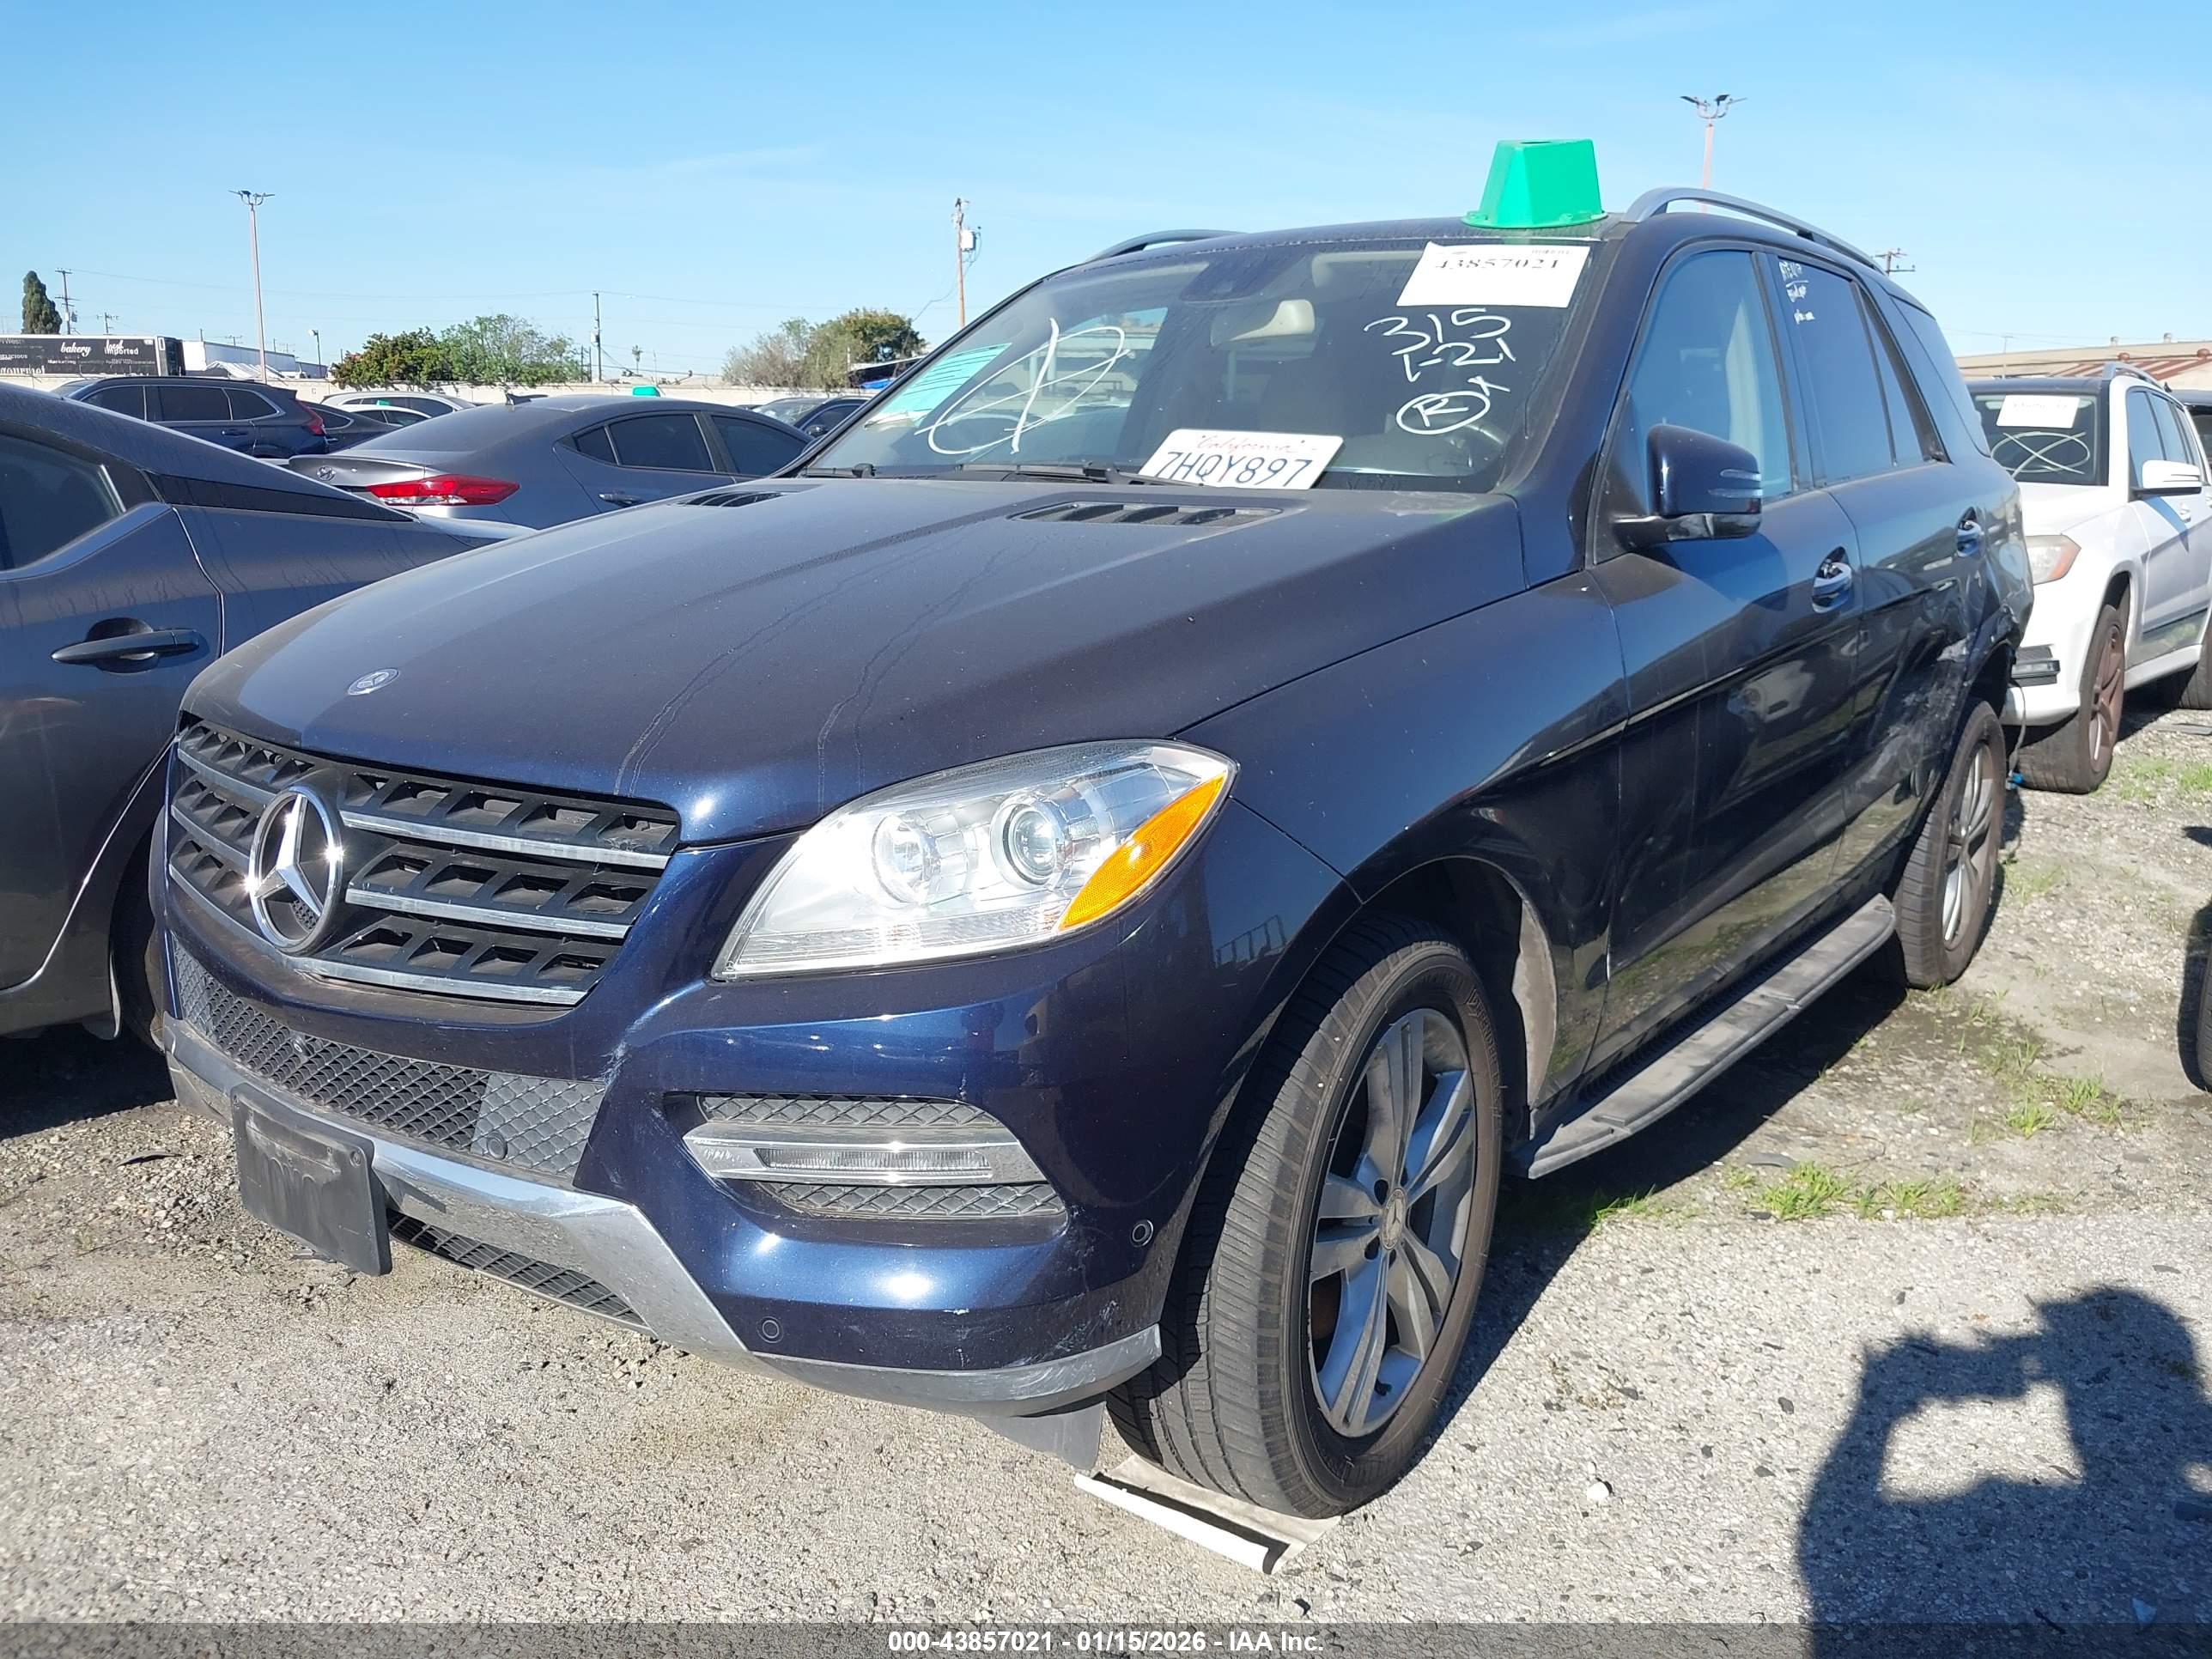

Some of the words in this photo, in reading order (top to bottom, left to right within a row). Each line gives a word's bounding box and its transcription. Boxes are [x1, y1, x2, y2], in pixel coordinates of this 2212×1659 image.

[1363, 307, 1512, 356] 315
[60, 342, 92, 356] bakery
[104, 346, 139, 356] imported
[1155, 451, 1313, 487] 7HQY897
